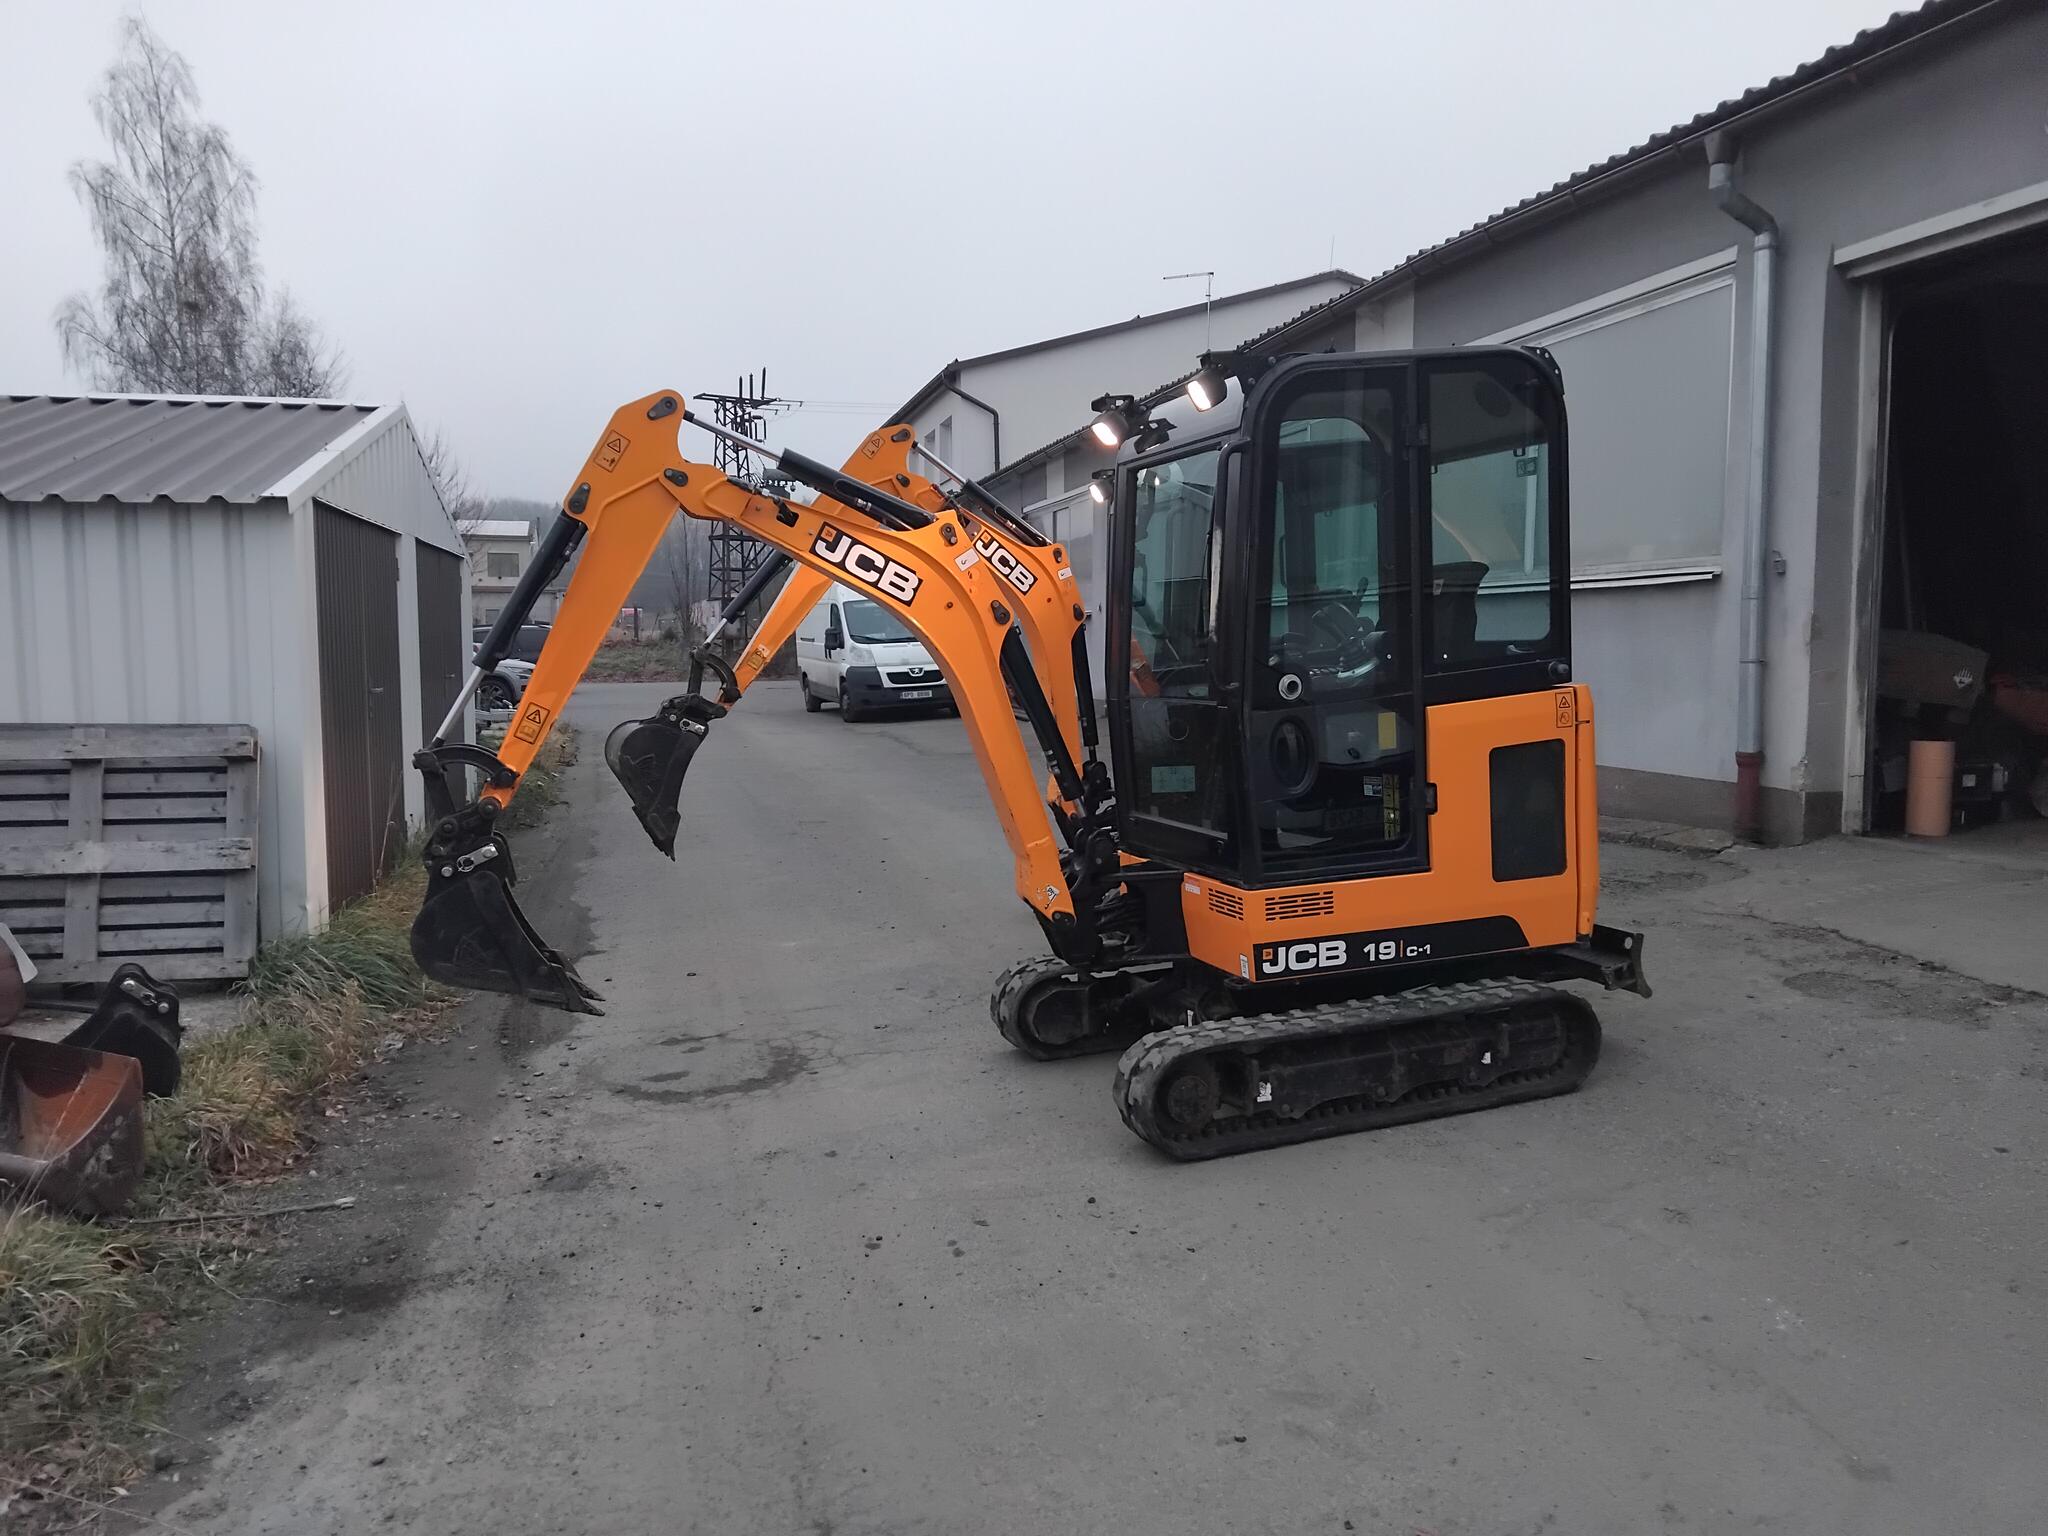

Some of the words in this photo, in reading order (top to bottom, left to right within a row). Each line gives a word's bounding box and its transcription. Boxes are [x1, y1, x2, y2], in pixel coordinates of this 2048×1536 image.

[815, 534, 919, 601] JCB
[975, 537, 1034, 592] JCB
[1262, 940, 1347, 974] JCB
[1363, 941, 1396, 962] 19
